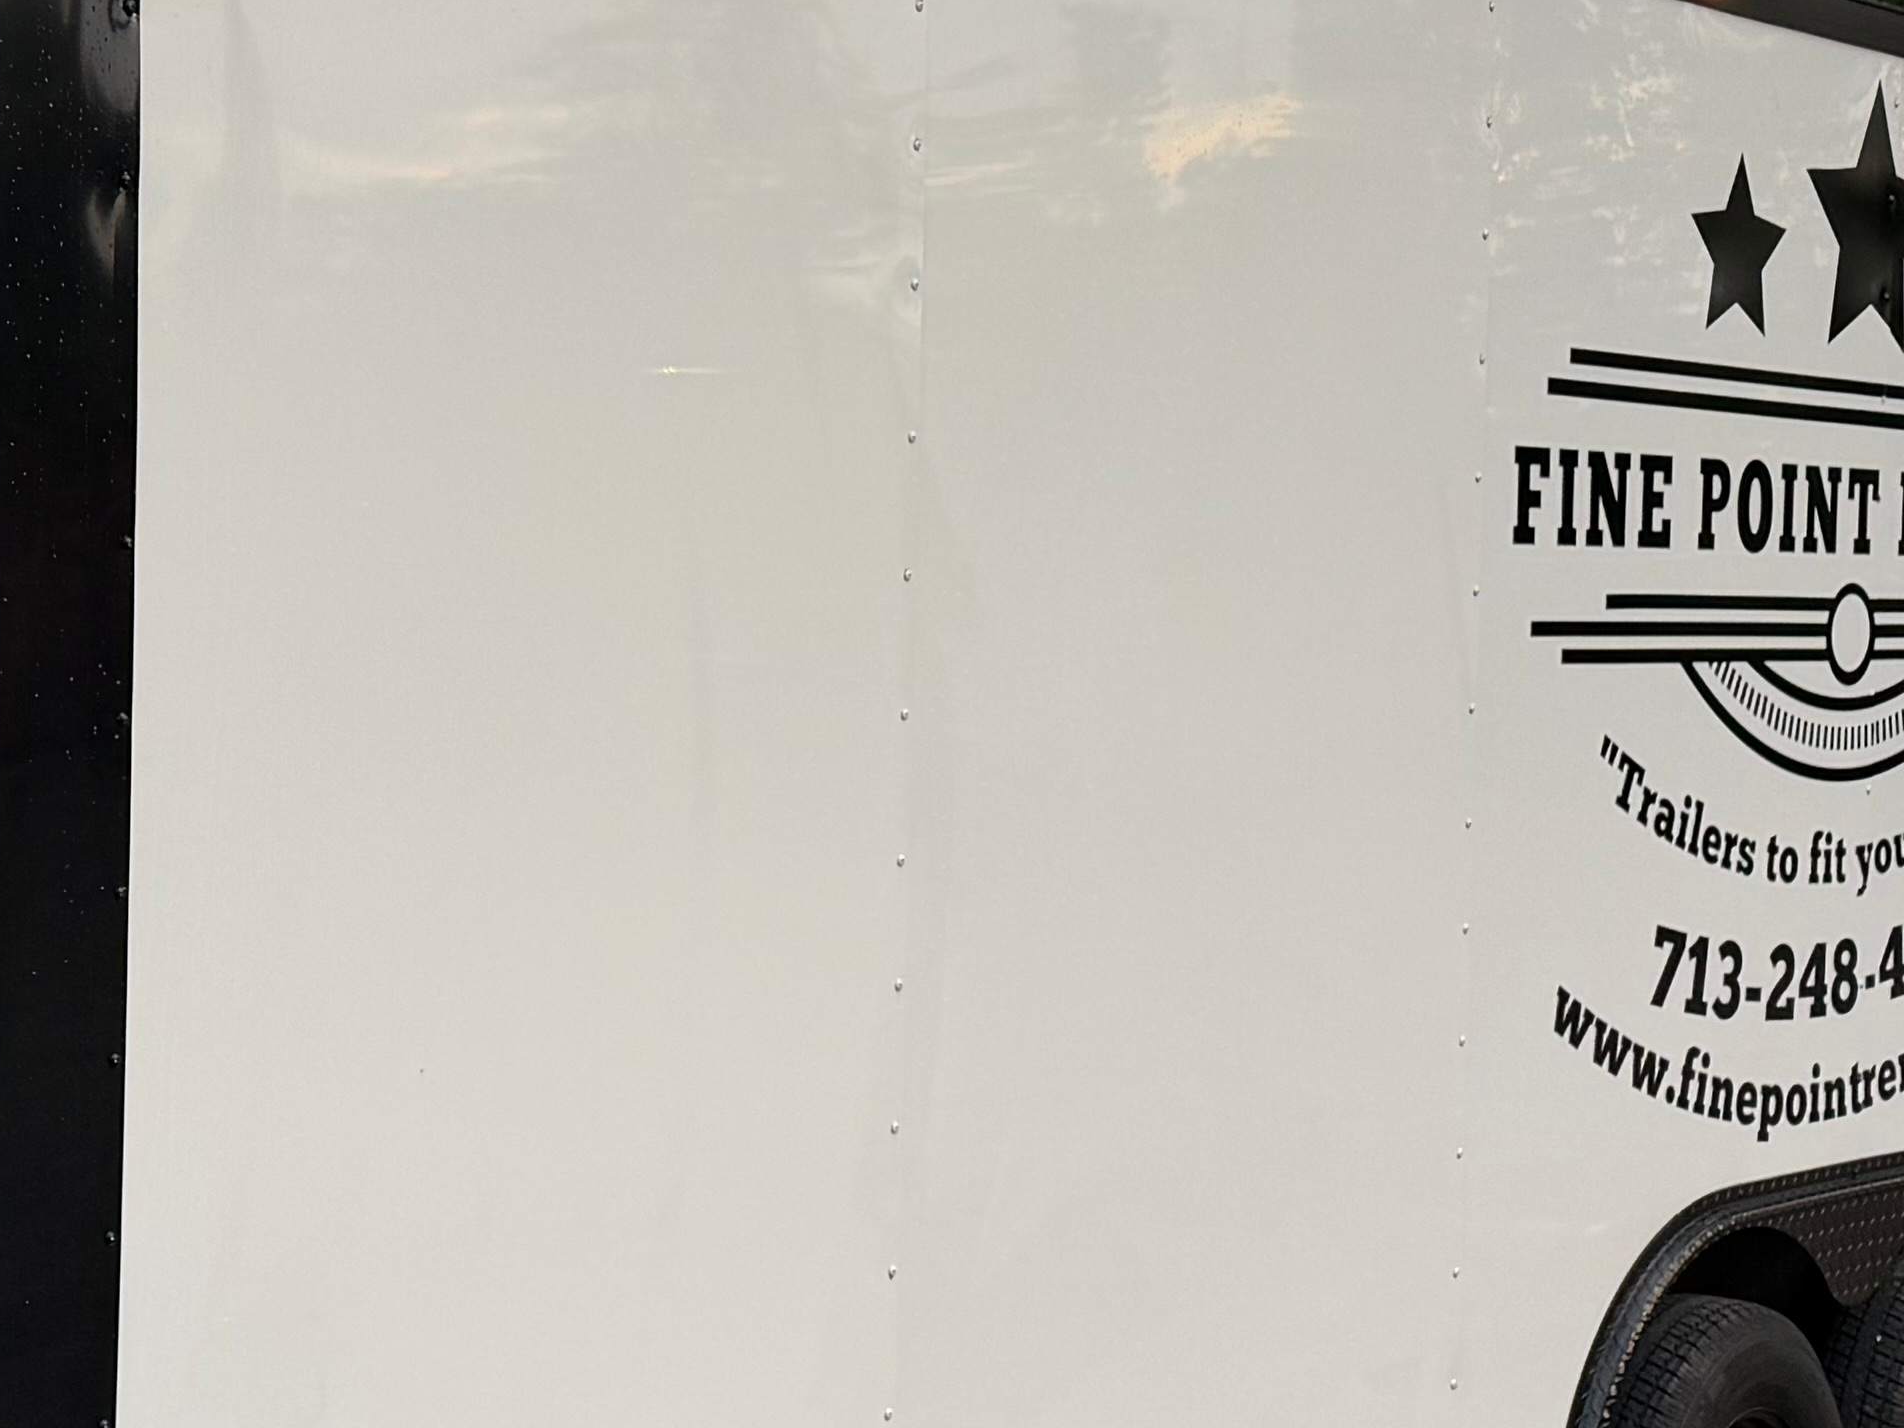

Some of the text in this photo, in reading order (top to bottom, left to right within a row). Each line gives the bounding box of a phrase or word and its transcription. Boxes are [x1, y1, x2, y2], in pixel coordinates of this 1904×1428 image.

[1512, 445, 1674, 550] FINE
[1697, 457, 1881, 555] POINT
[1599, 734, 1757, 877] "Trailers
[1765, 835, 1800, 885] to
[1808, 830, 1848, 885] fit
